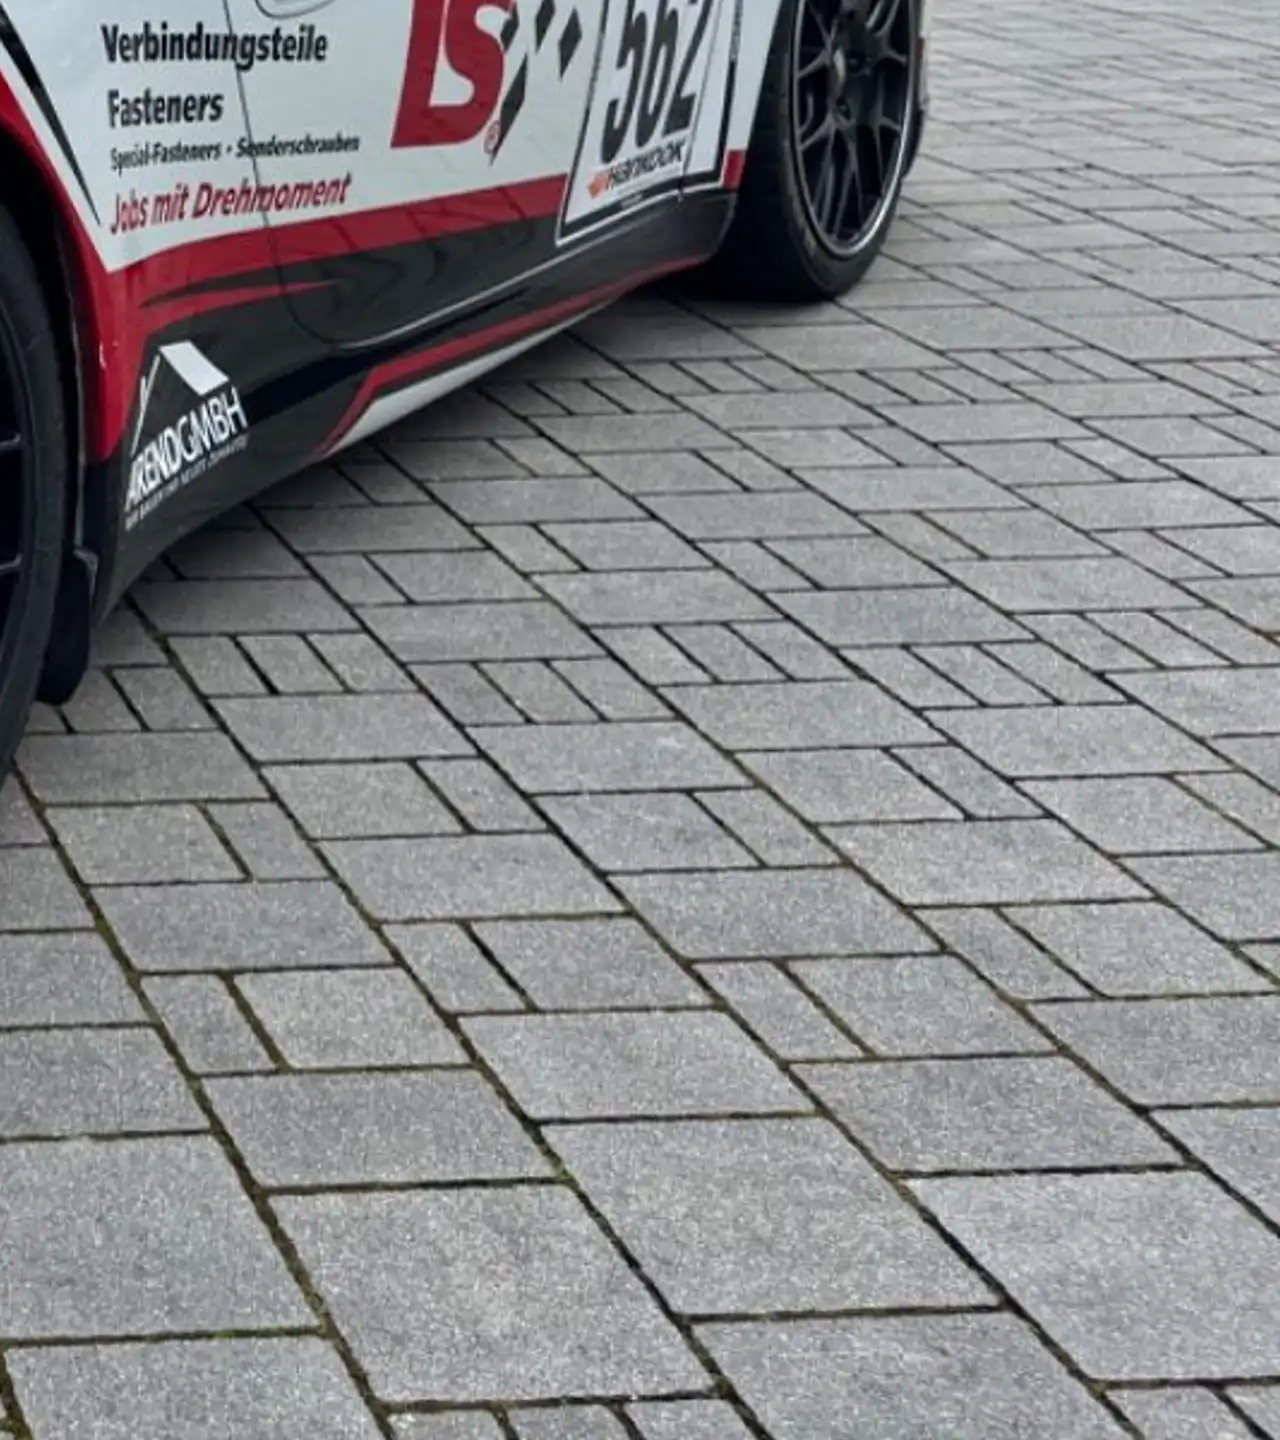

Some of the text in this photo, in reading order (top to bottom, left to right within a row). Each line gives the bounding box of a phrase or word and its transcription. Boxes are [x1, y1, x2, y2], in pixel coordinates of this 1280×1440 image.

[101, 21, 329, 72] Verbindungsteile
[107, 87, 225, 129] Fasteners
[235, 130, 361, 159] Sonderschrauben
[109, 171, 353, 235] Jobs mit Drehmoment
